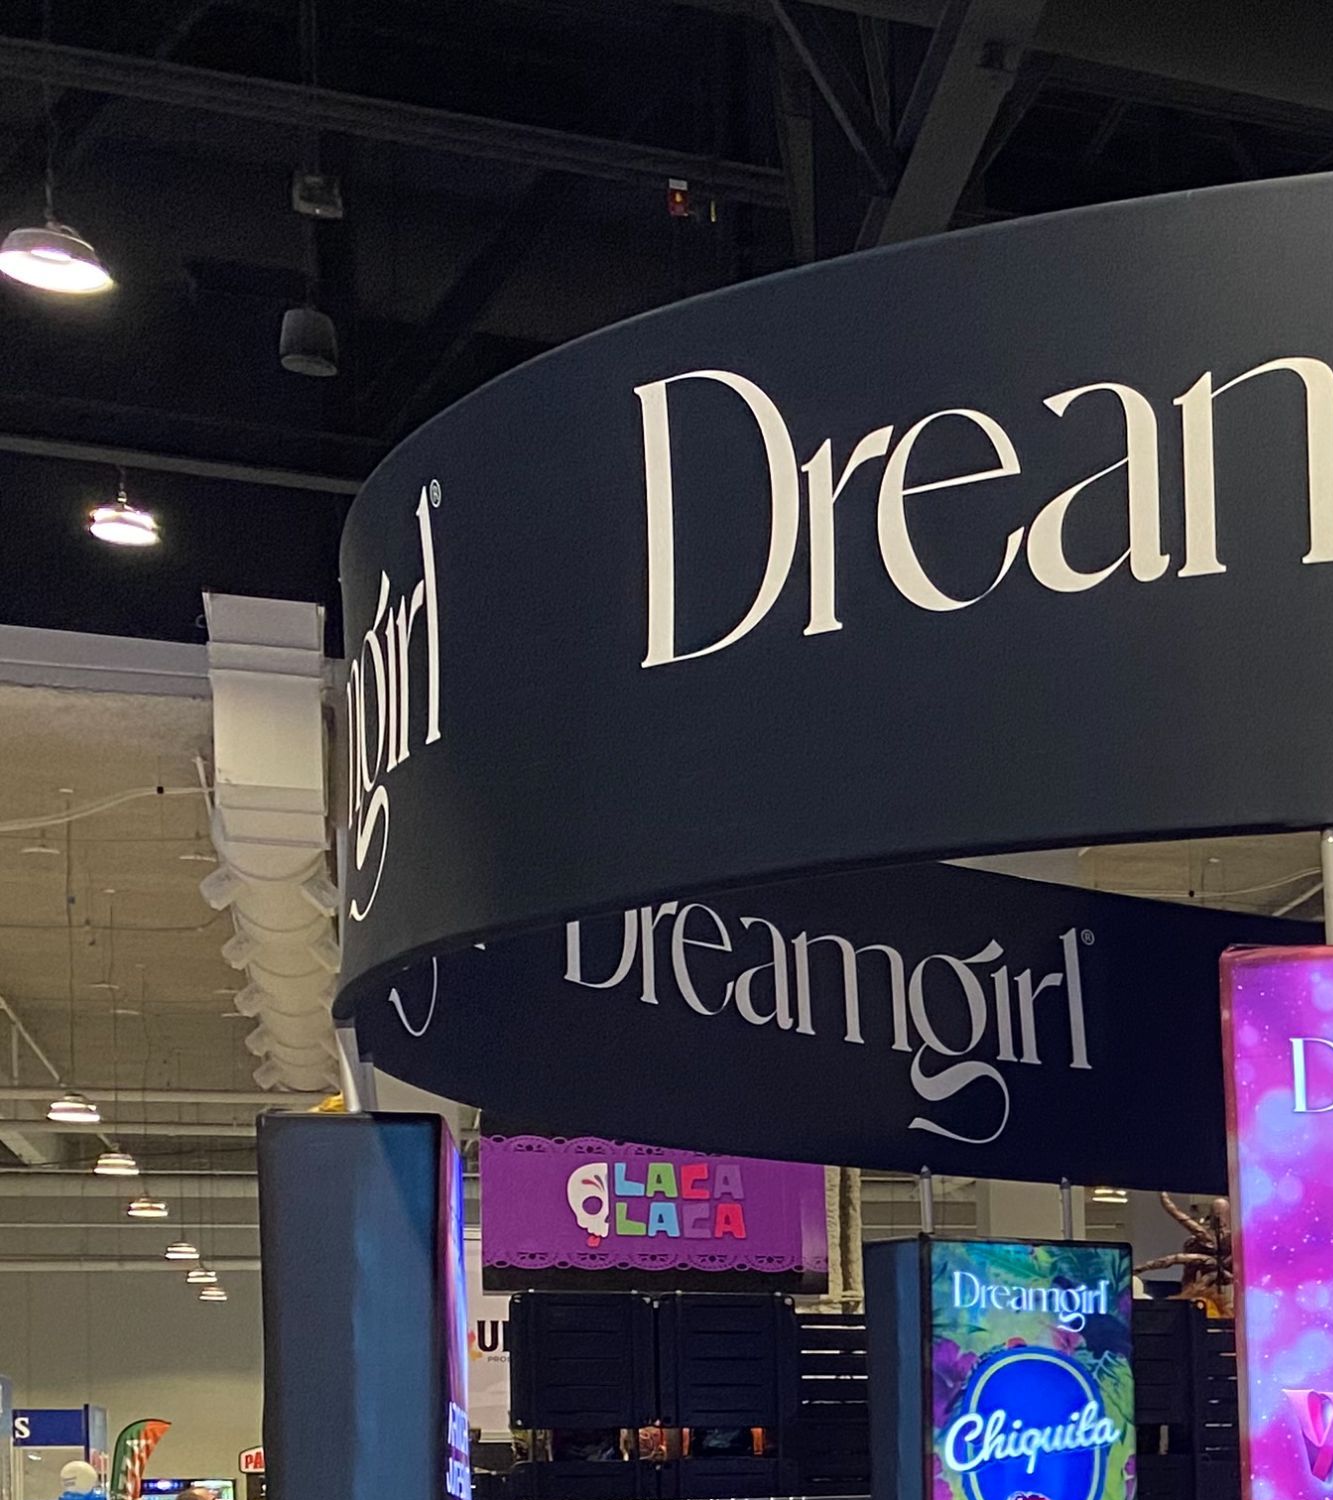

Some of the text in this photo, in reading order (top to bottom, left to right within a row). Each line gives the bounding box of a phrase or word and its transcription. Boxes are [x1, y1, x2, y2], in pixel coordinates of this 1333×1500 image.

[614, 1162, 745, 1200] LACA
[615, 1202, 747, 1239] LACA
[954, 1271, 1110, 1332] Dreamgirl
[944, 1399, 1122, 1475] Chiquita
